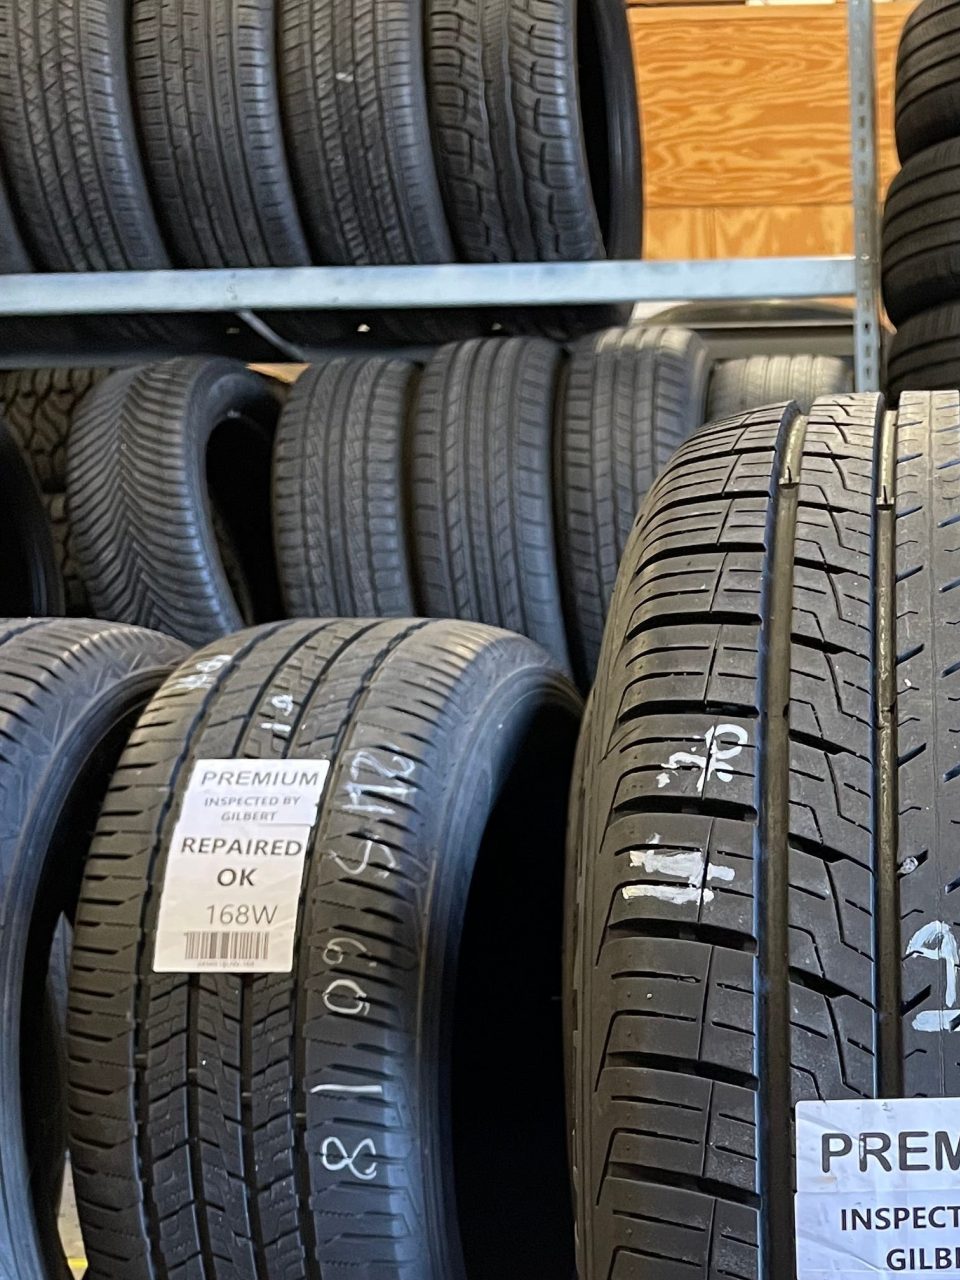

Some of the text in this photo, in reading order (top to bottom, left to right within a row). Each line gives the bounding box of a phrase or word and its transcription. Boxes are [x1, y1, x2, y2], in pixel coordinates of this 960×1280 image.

[201, 770, 319, 787] PREMIUM
[204, 796, 301, 808] INSPECTED BY
[220, 811, 279, 822] GILBERT
[181, 837, 302, 857] REPAIRED
[216, 868, 258, 887] OK
[205, 904, 279, 925] 168W
